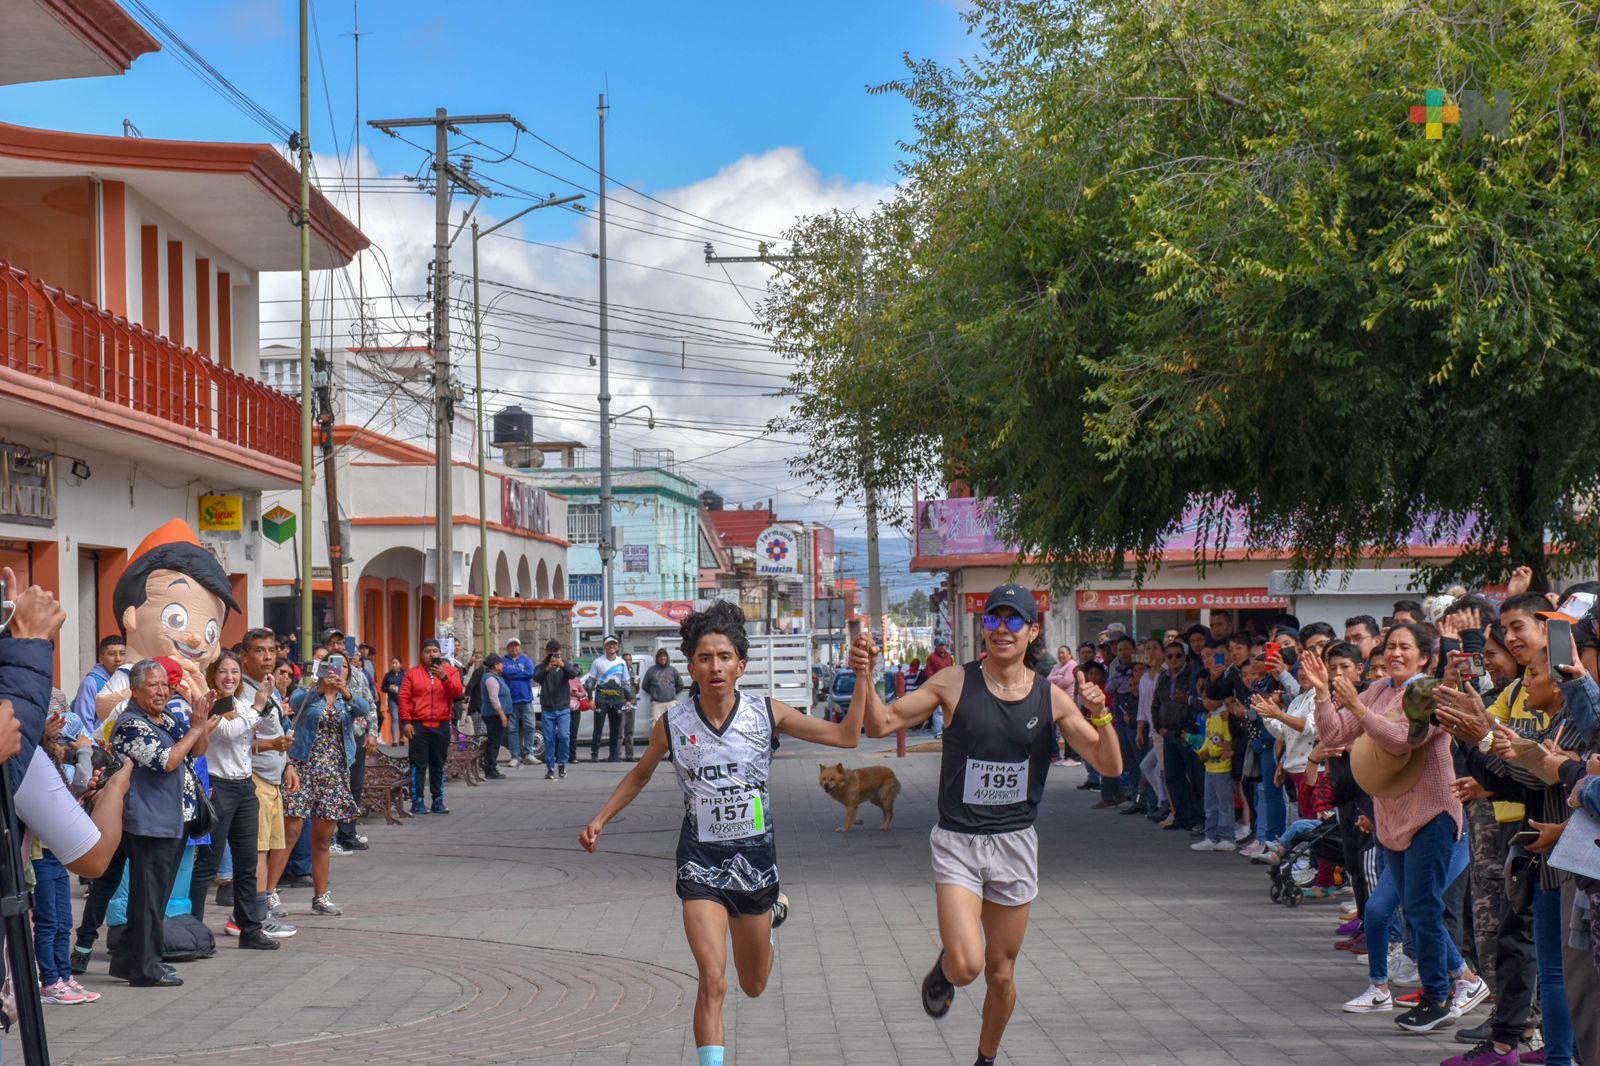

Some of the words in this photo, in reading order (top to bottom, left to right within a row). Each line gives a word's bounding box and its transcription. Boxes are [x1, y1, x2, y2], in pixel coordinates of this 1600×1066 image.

[686, 763, 738, 781] WOLF
[971, 762, 1015, 773] PIRMA
[980, 773, 1018, 788] 195
[701, 795, 744, 806] PIRMA
[710, 803, 749, 821] 157
[708, 822, 731, 834] 498
